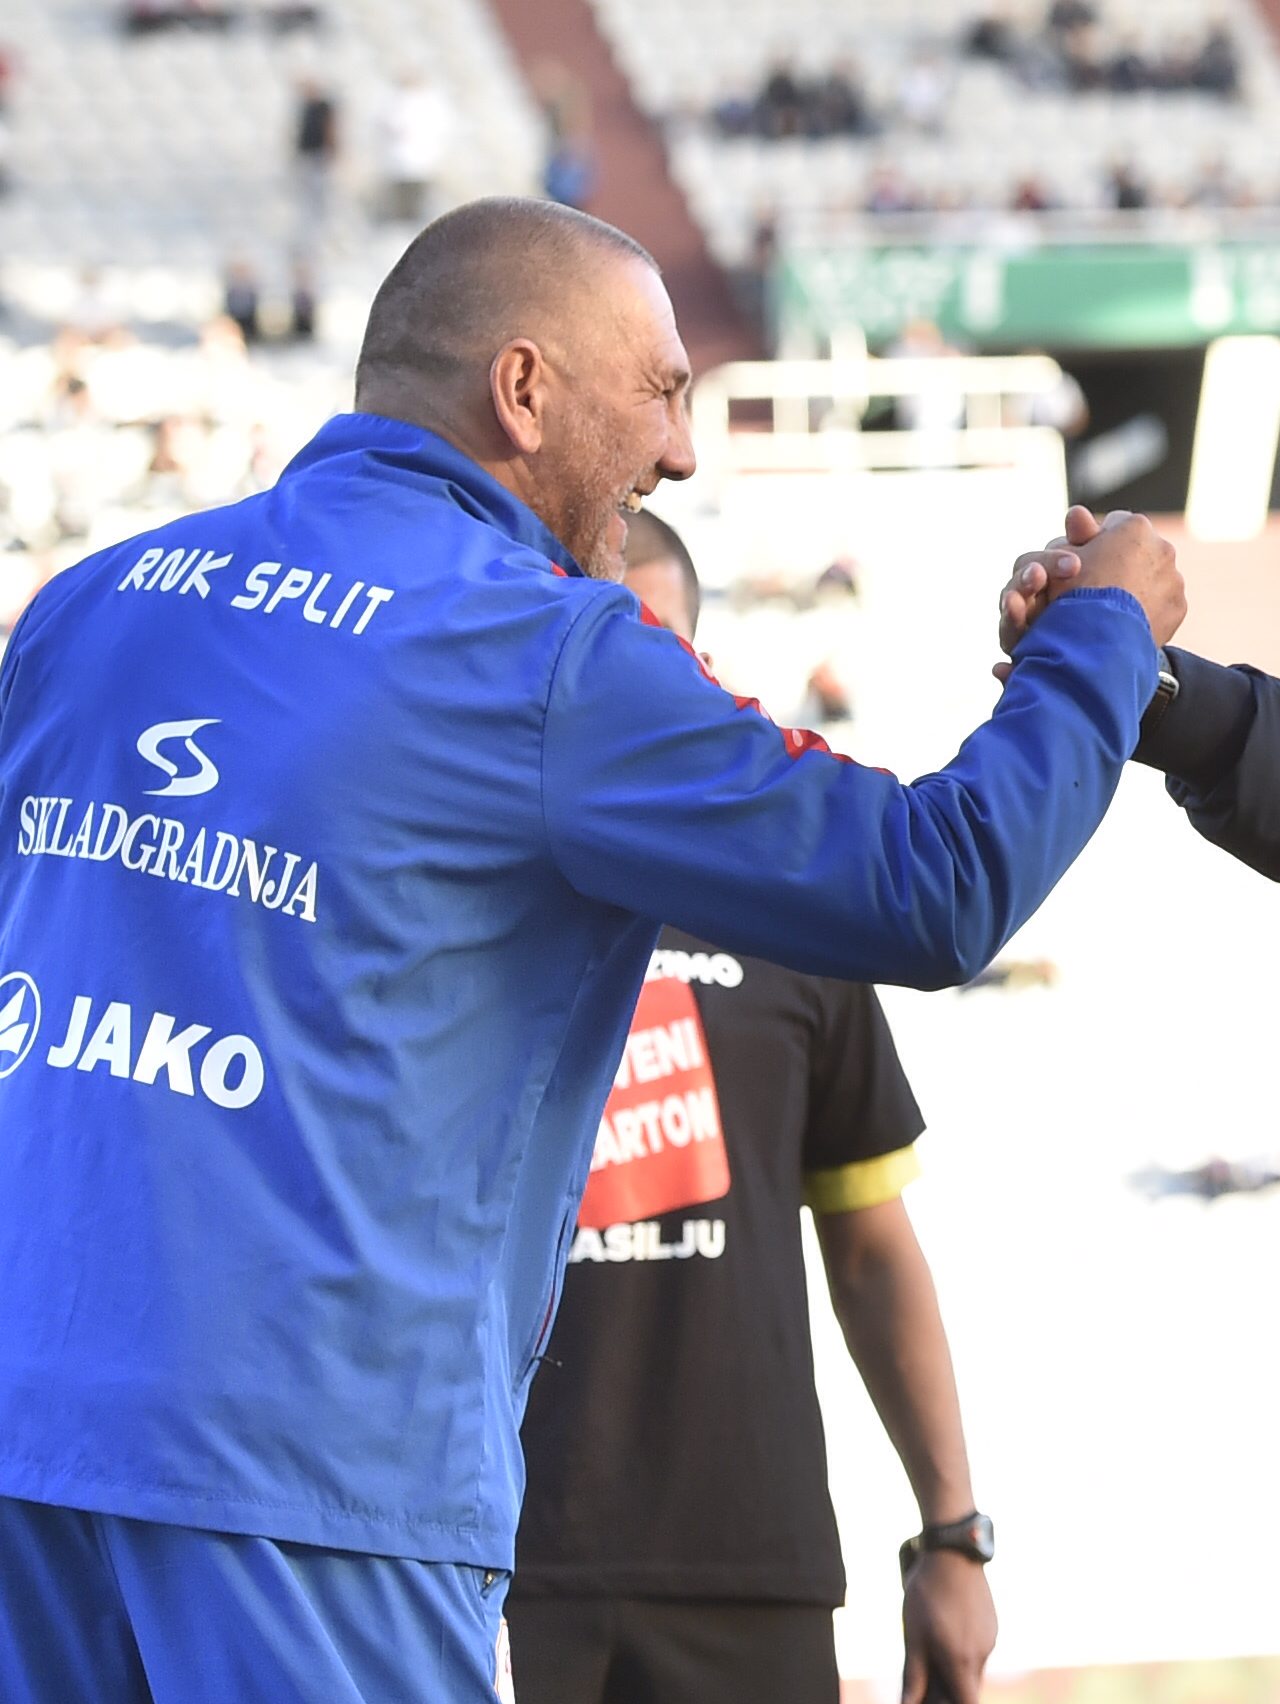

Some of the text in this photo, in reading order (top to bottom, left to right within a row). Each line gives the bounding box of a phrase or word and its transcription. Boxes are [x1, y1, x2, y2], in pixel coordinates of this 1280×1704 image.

[117, 548, 395, 635] RNK SPLIT
[17, 794, 318, 923] SKLADGRADNJA
[47, 995, 264, 1109] JAKO
[613, 1016, 705, 1090] VENI
[590, 1086, 718, 1173] ARTON
[568, 1219, 726, 1264] ASILJU
